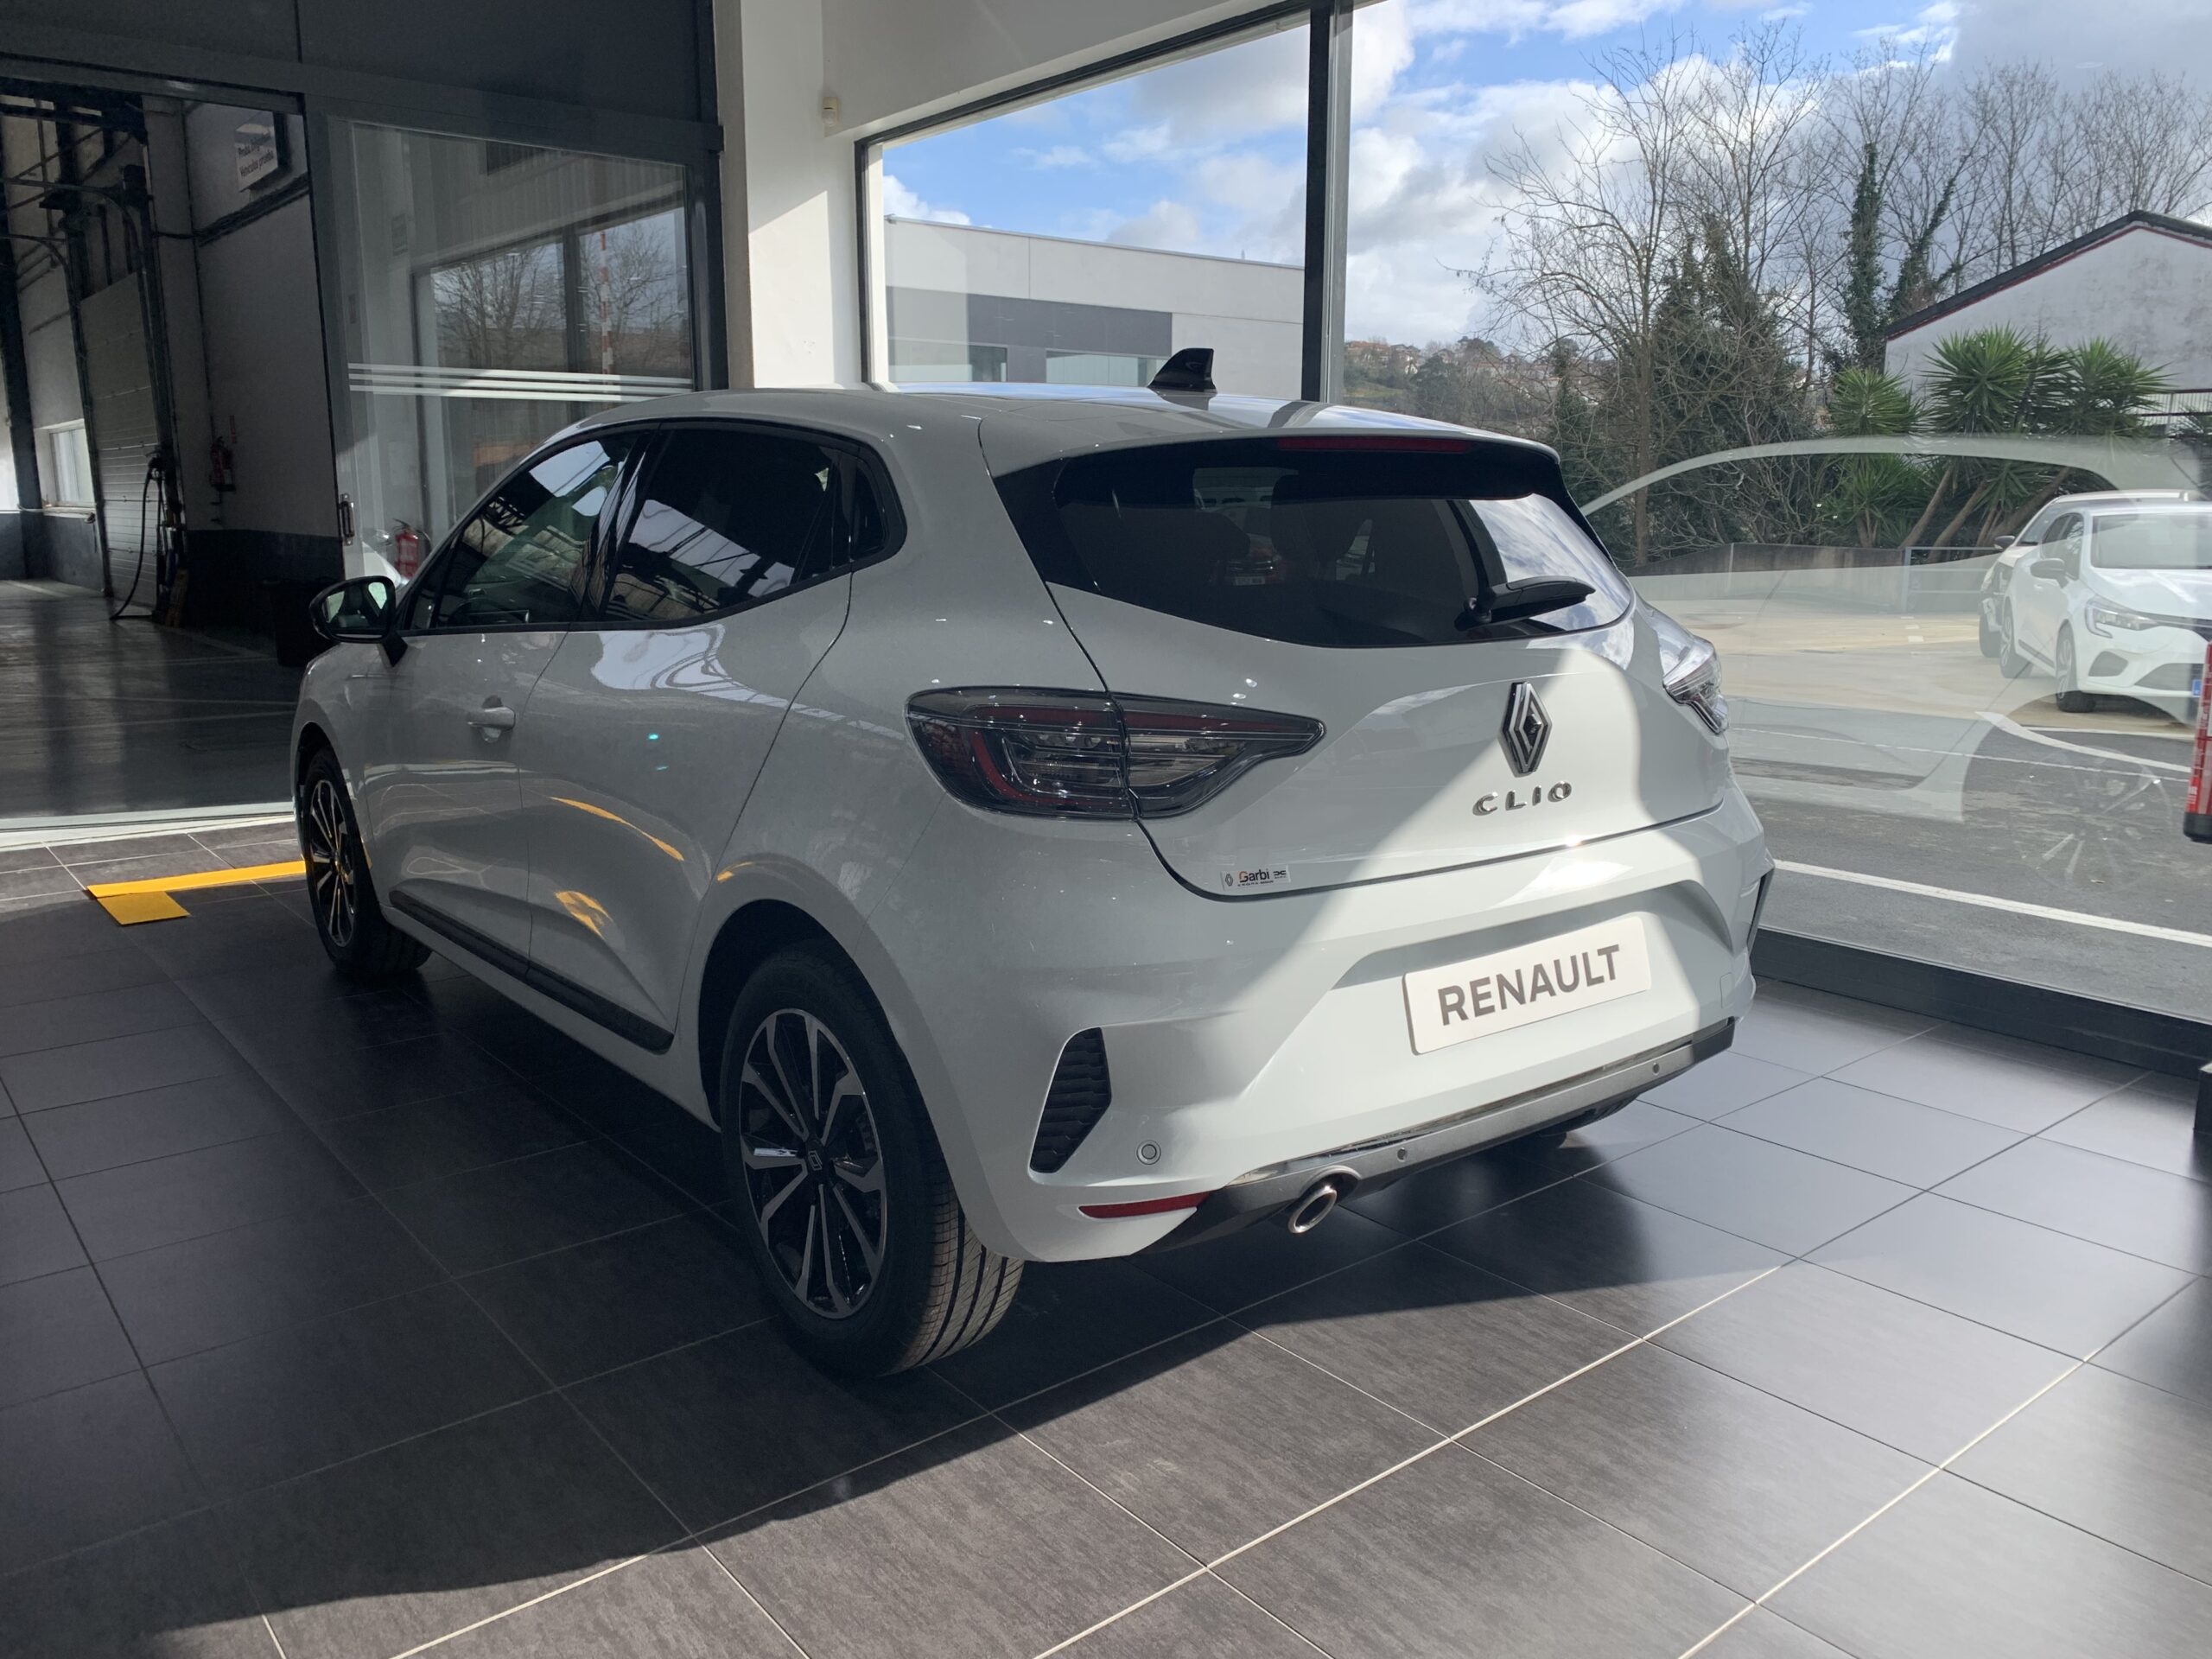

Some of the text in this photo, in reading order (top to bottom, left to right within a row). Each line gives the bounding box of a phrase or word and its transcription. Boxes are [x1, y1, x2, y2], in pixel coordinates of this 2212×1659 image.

[1474, 780, 1573, 816] CLIO
[1239, 868, 1270, 883] Garbi
[1437, 944, 1620, 1027] RENAULT
